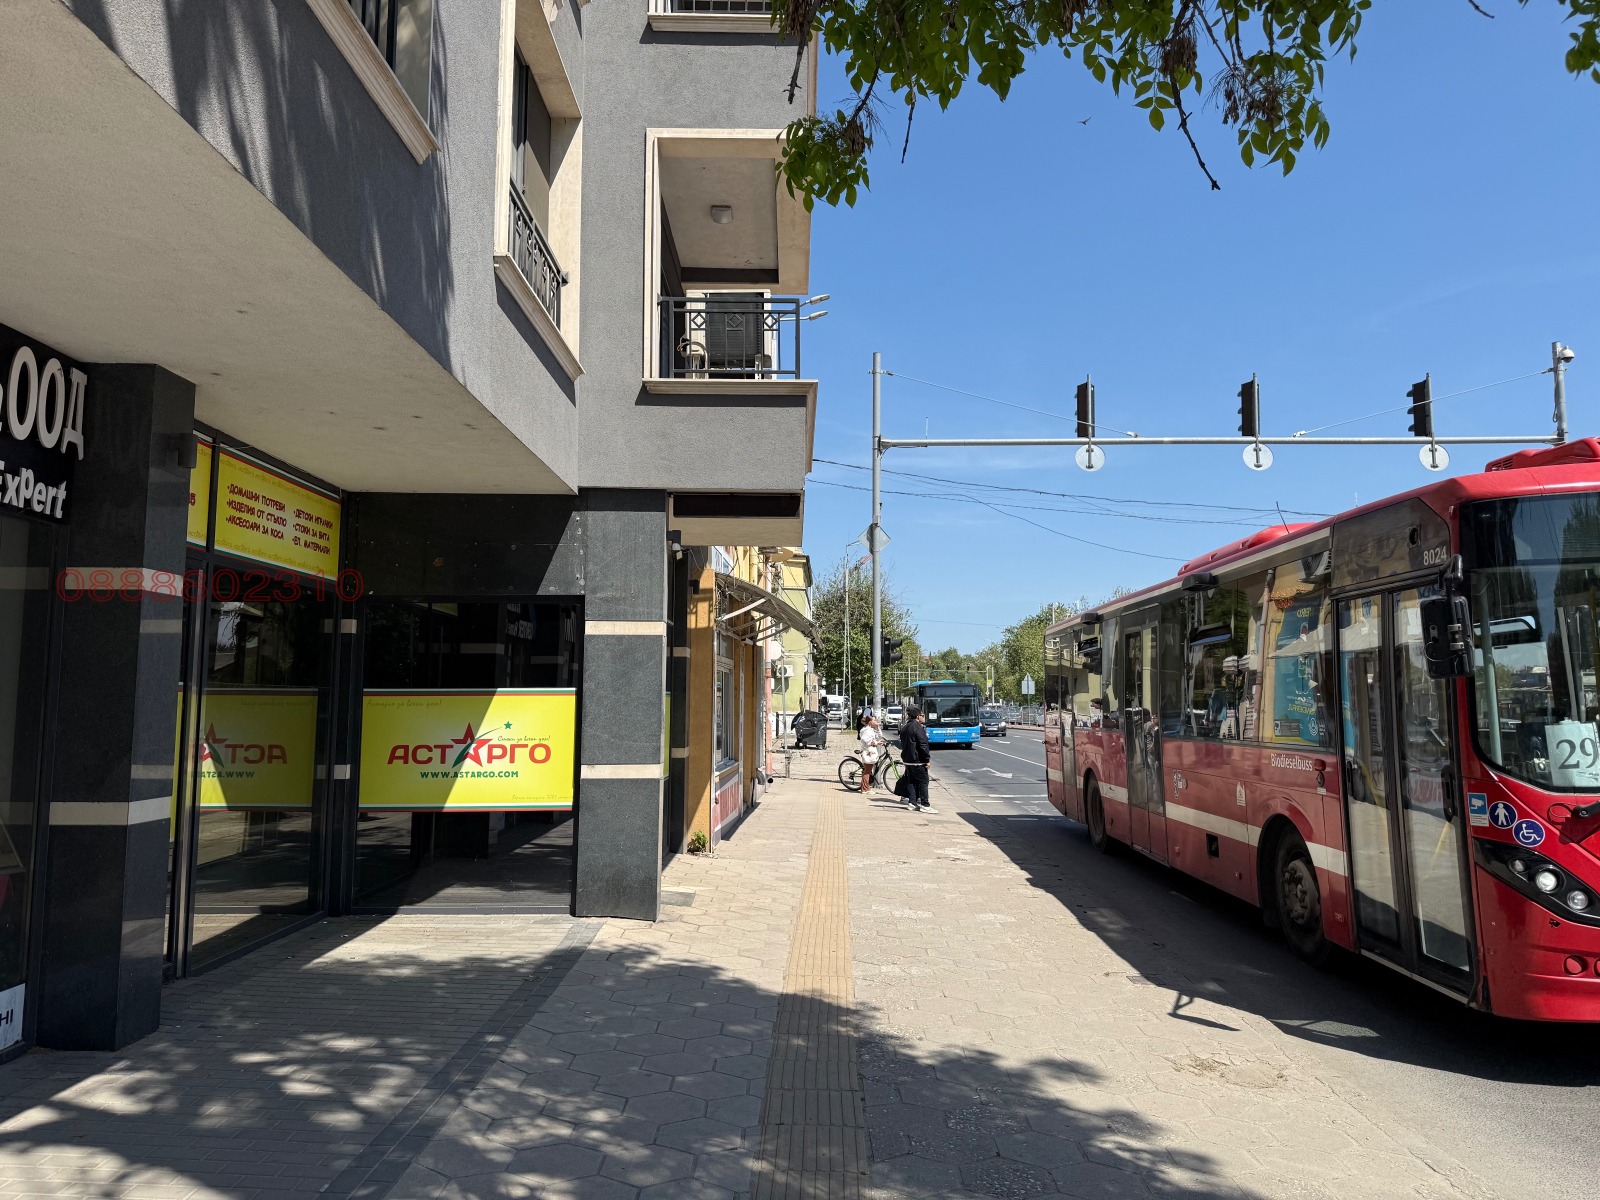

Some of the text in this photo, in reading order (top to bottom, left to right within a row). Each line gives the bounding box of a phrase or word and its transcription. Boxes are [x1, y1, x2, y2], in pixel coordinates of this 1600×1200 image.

[229, 483, 260, 504] ДОМАШНИ
[261, 494, 286, 513] ПОТРЕБИ
[228, 498, 287, 527] ИЗДЕЛИЯ ОТ СТЪКЛО
[295, 508, 314, 523] ДЕТСКИ
[227, 514, 285, 541] АКСЕСОАРИ ЗА КОСА
[294, 522, 331, 543] СТОКИ ЗА БИТА
[303, 539, 331, 556] МАТЕРИАЛИ
[1423, 545, 1448, 566] 8024
[1271, 753, 1313, 772] Biodieselbuss
[1555, 737, 1600, 770] 29
[420, 770, 519, 779] WWW.ASTARGO.COM
